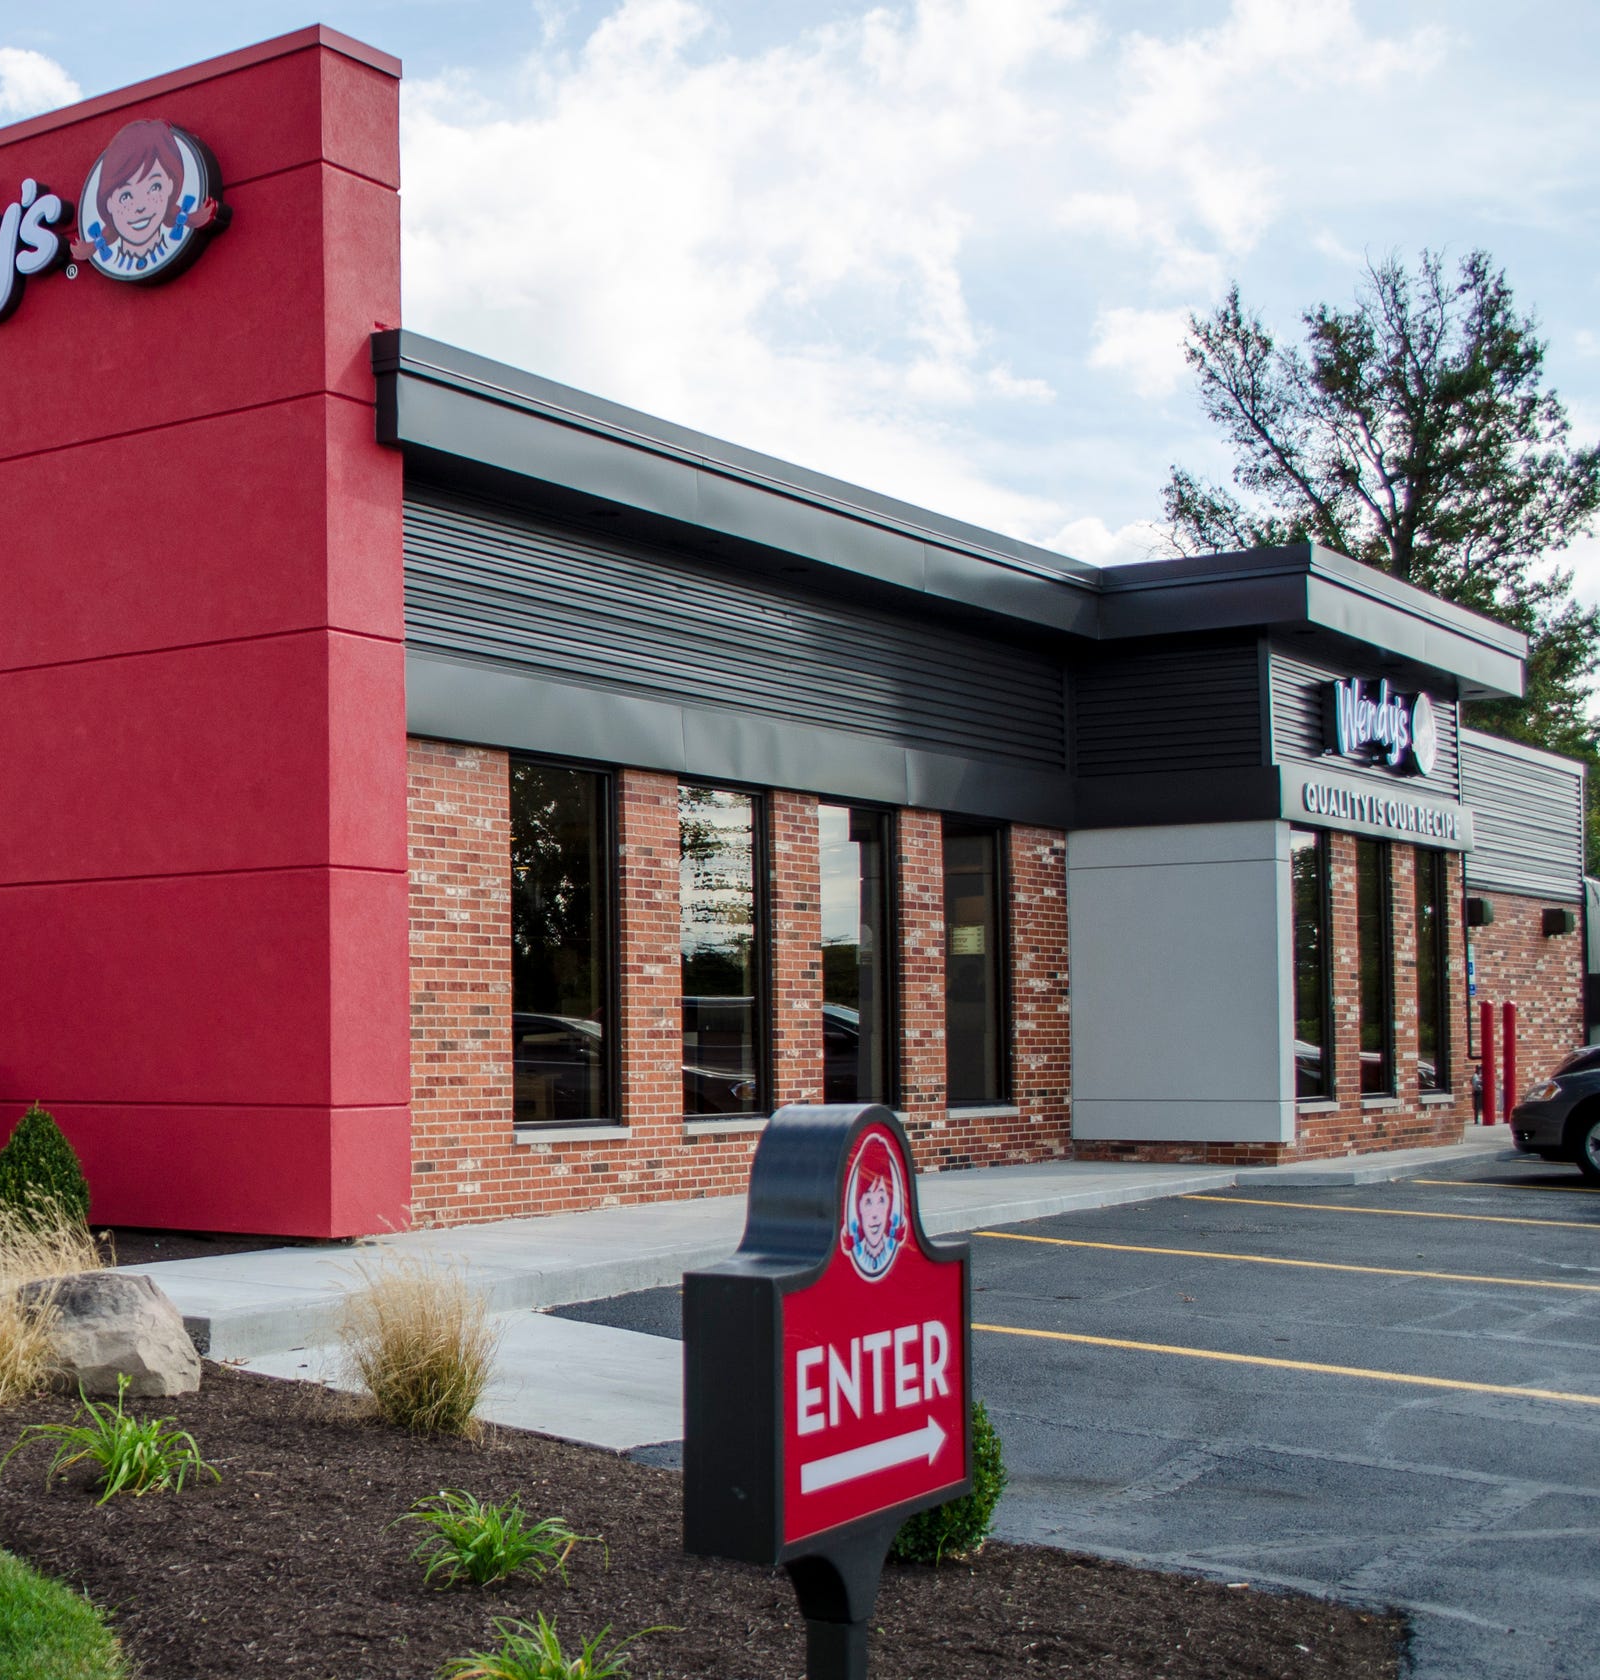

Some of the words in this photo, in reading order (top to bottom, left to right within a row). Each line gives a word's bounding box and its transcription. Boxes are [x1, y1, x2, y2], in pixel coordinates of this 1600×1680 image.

[1335, 677, 1408, 766] Wendy's
[1304, 782, 1370, 823] QUALITY
[1369, 796, 1385, 826] IS
[1387, 800, 1416, 832] OUR
[1417, 807, 1461, 841] RECIPE
[795, 1319, 951, 1437] ENTER
